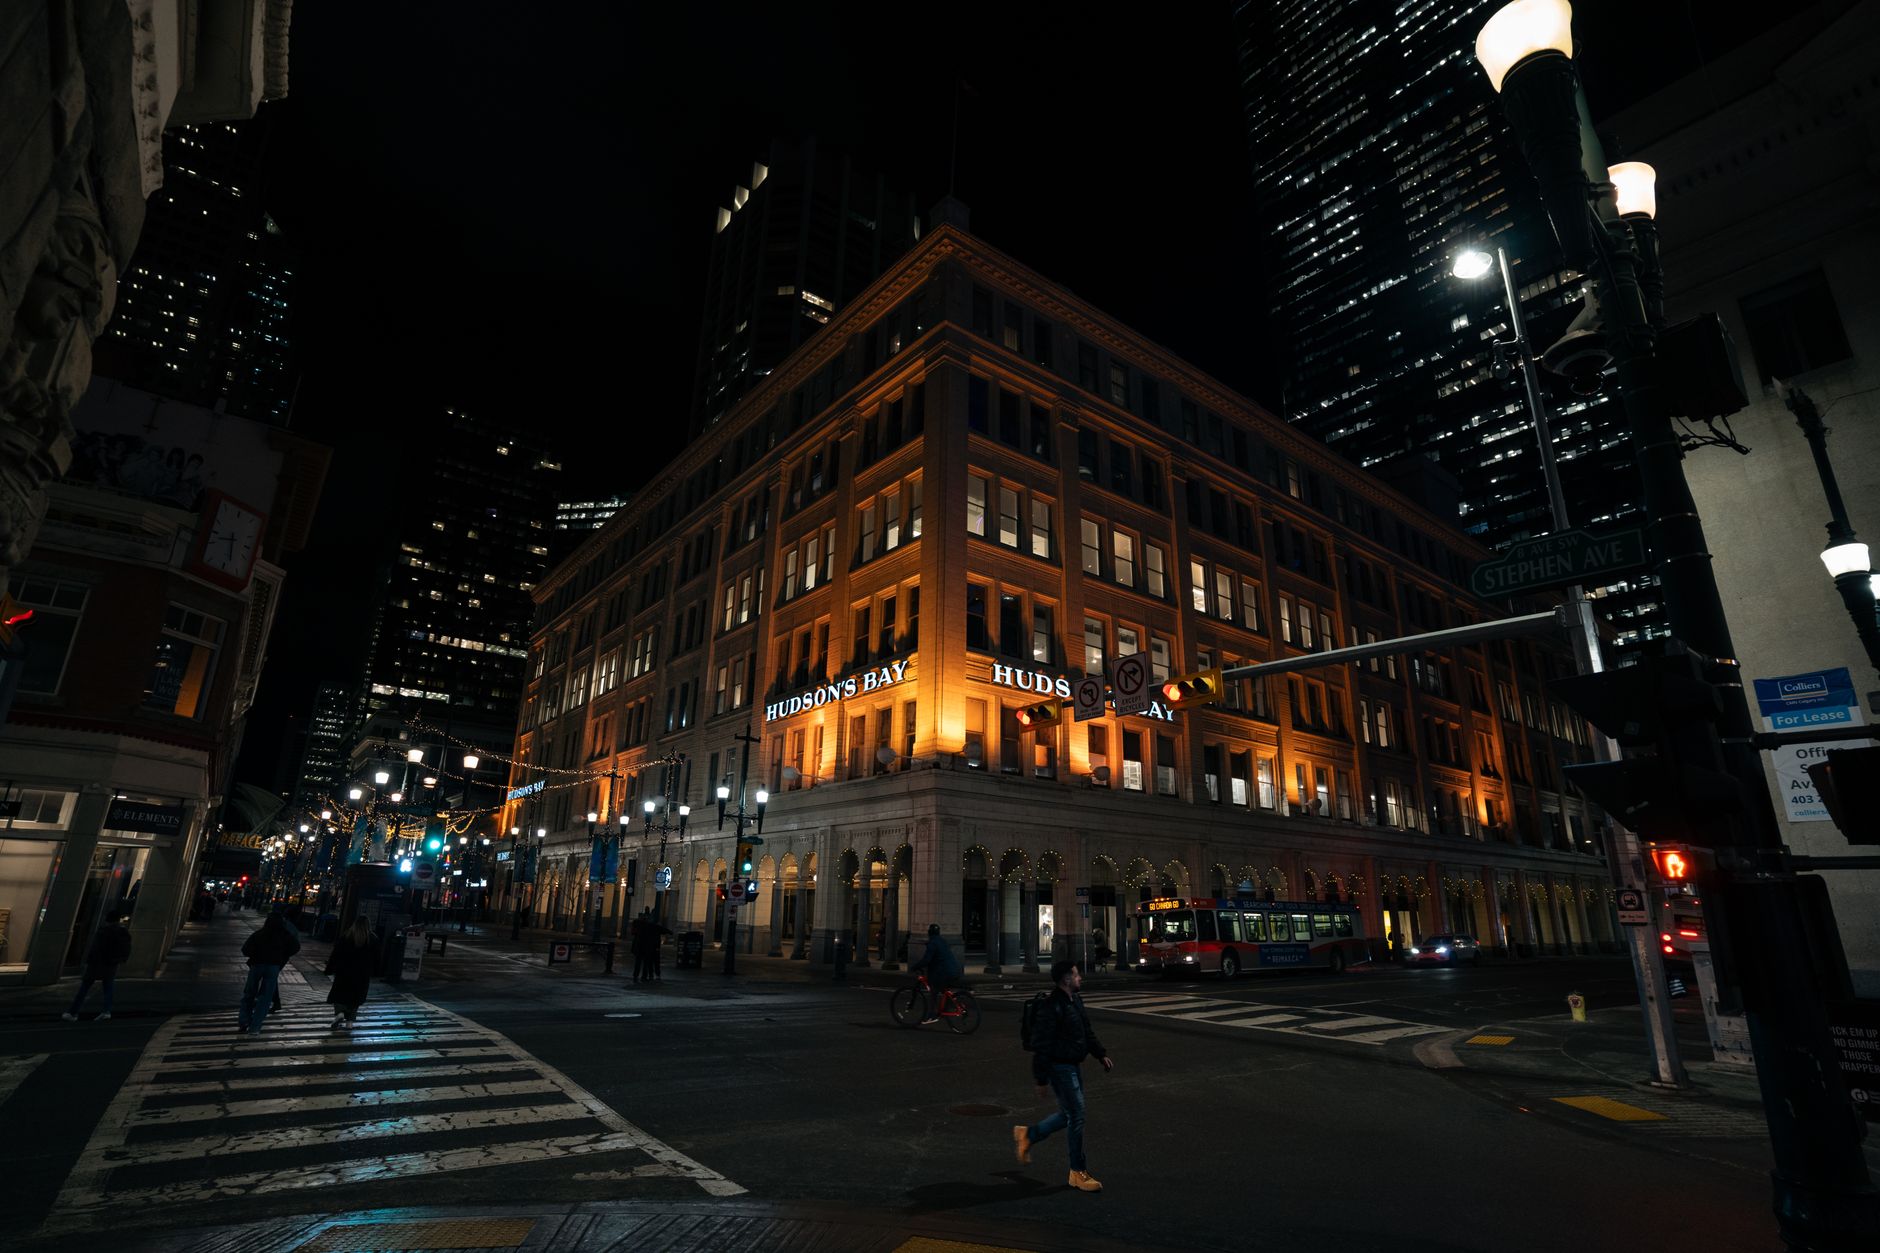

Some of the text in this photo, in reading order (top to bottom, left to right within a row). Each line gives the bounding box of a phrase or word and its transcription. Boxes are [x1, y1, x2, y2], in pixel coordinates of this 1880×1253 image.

[1531, 542, 1553, 556] AVE
[1559, 535, 1580, 550] SW
[1483, 540, 1624, 590] STEPHEN AVE
[766, 660, 908, 722] HUDSON'S BAY
[1783, 682, 1821, 692] Colliers
[1121, 696, 1142, 705] EXCEPT
[1120, 703, 1145, 713] BICYCLES
[1776, 711, 1846, 726] For Lease
[1791, 795, 1814, 804] 403
[123, 810, 180, 825] ELEMENTS
[1149, 900, 1180, 911] GO CANADA GO
[1832, 1026, 1878, 1038] ICK EM UP
[1833, 1038, 1880, 1050] ND GIMME
[1841, 1049, 1872, 1061] THOSE
